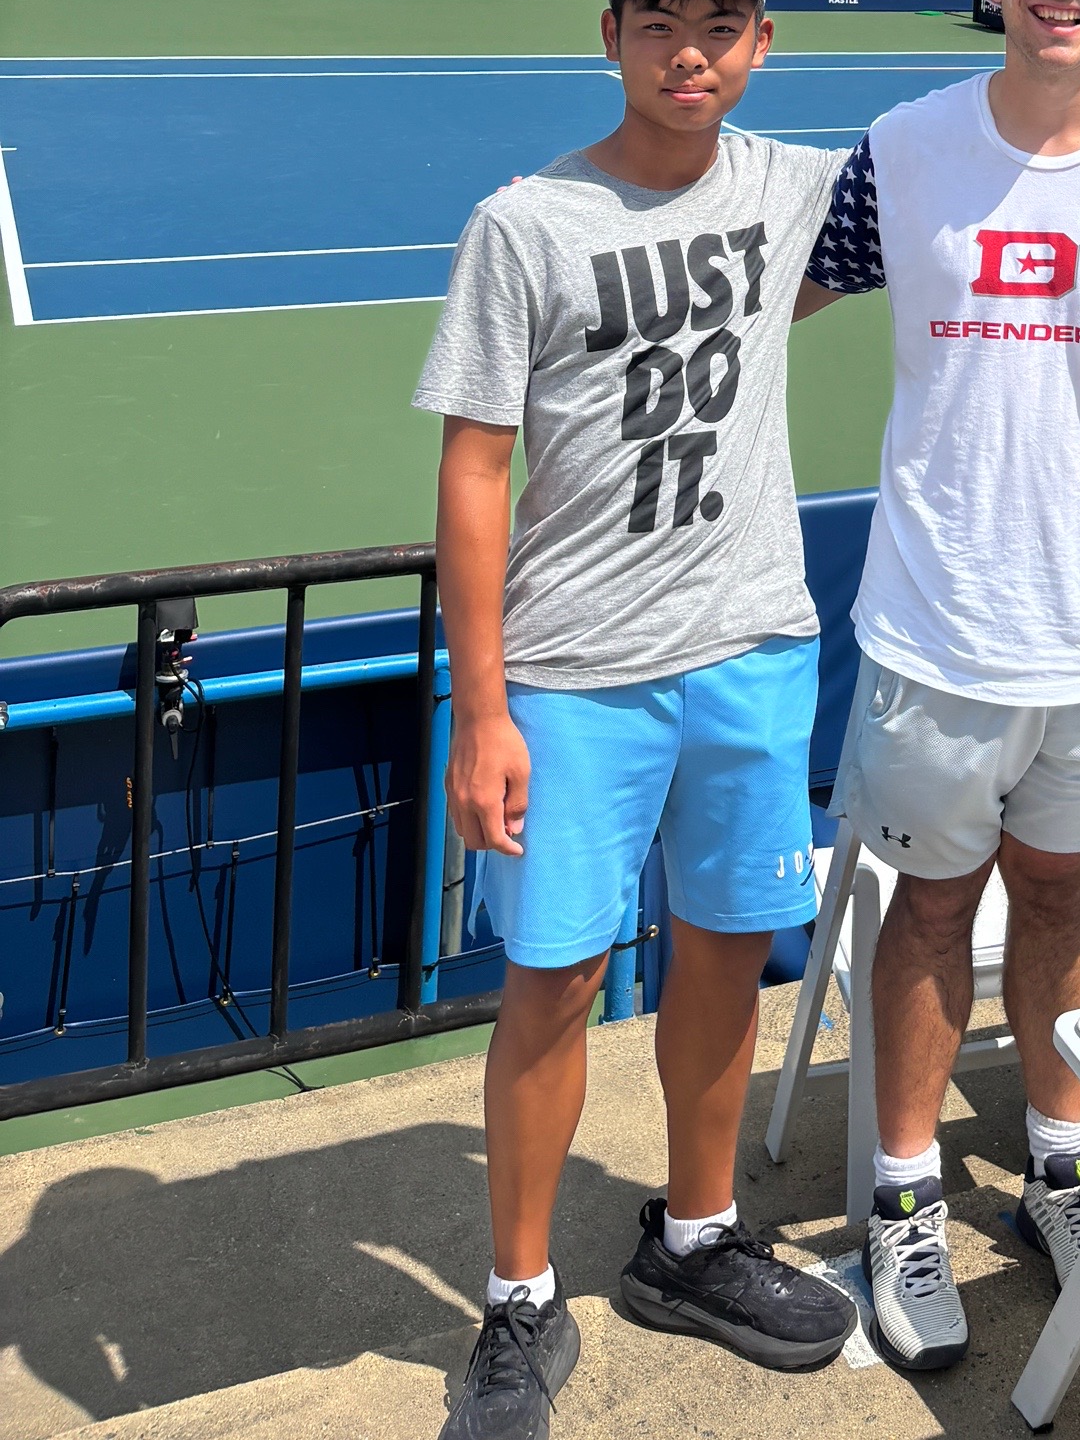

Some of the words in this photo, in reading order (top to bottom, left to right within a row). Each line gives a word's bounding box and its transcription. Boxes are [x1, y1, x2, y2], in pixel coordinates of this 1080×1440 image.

[584, 221, 769, 353] JUST
[621, 327, 742, 441] DO
[627, 431, 724, 534] IT.
